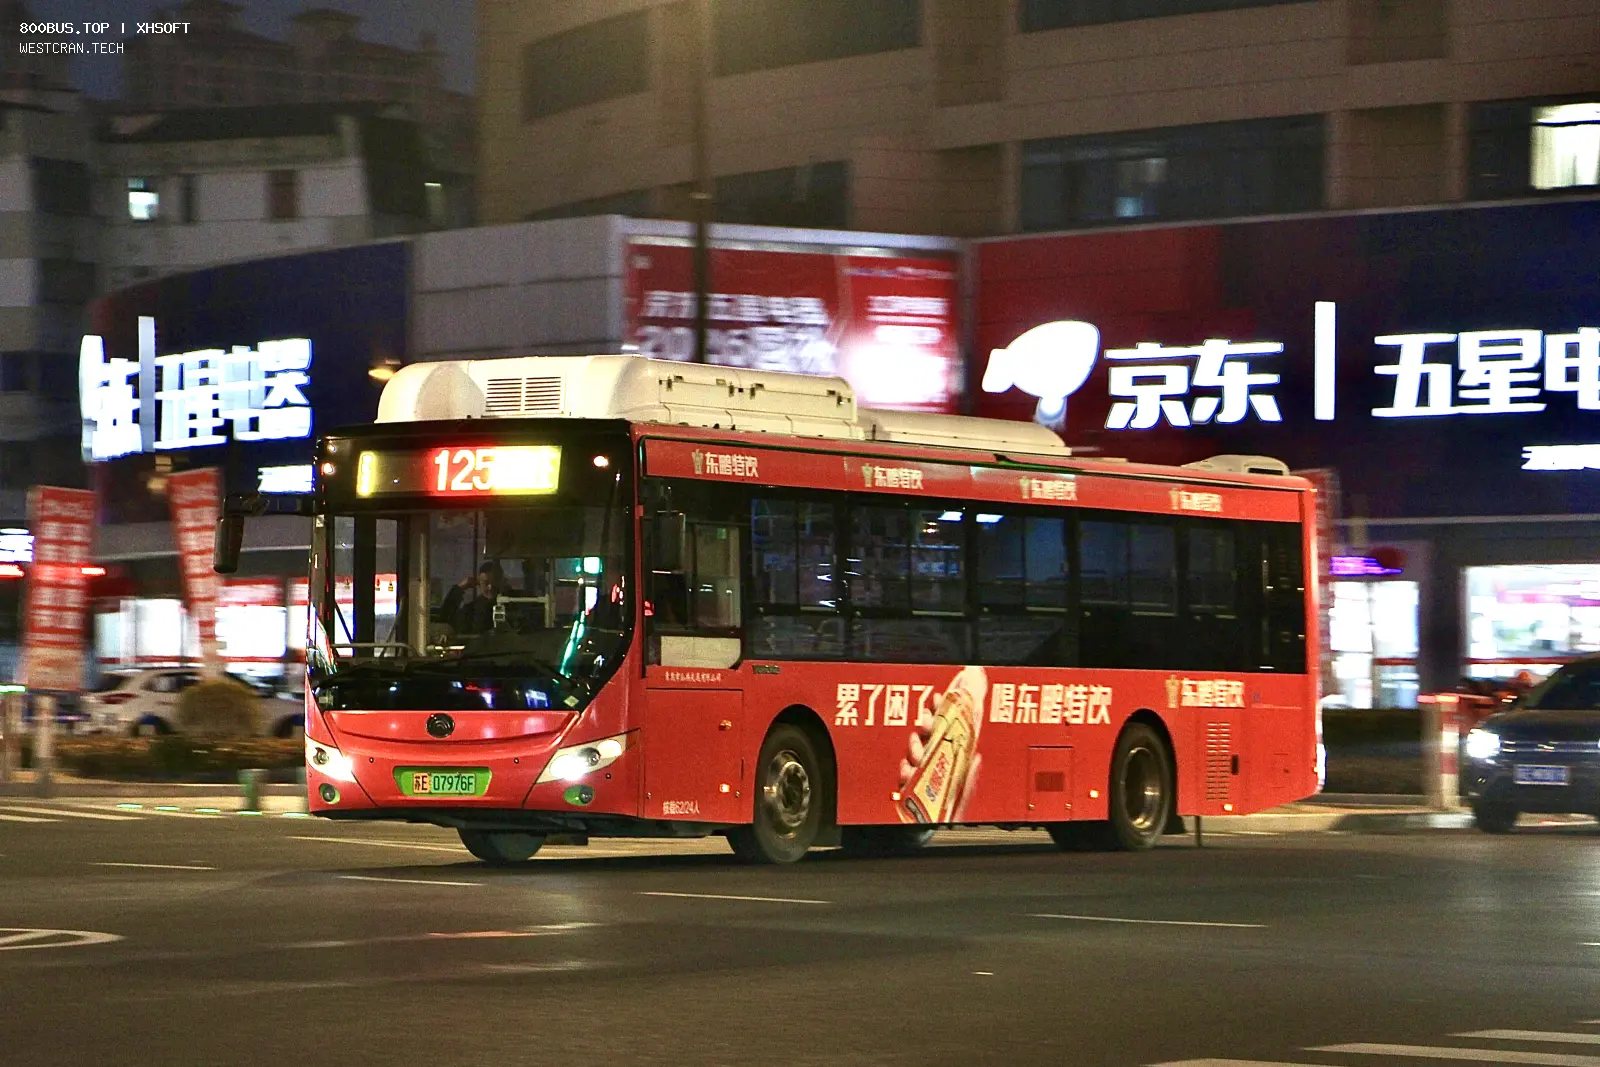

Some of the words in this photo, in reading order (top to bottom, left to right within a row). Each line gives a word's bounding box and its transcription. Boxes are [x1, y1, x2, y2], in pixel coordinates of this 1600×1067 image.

[1103, 340, 1284, 429] 京东
[1371, 327, 1600, 416] 五星电
[434, 448, 496, 491] 125
[705, 452, 759, 478] 东鹏特饮
[873, 465, 924, 490] 东鹏特饮
[834, 683, 935, 727] 累了困了
[989, 682, 1113, 725] 喝东鹏特饮
